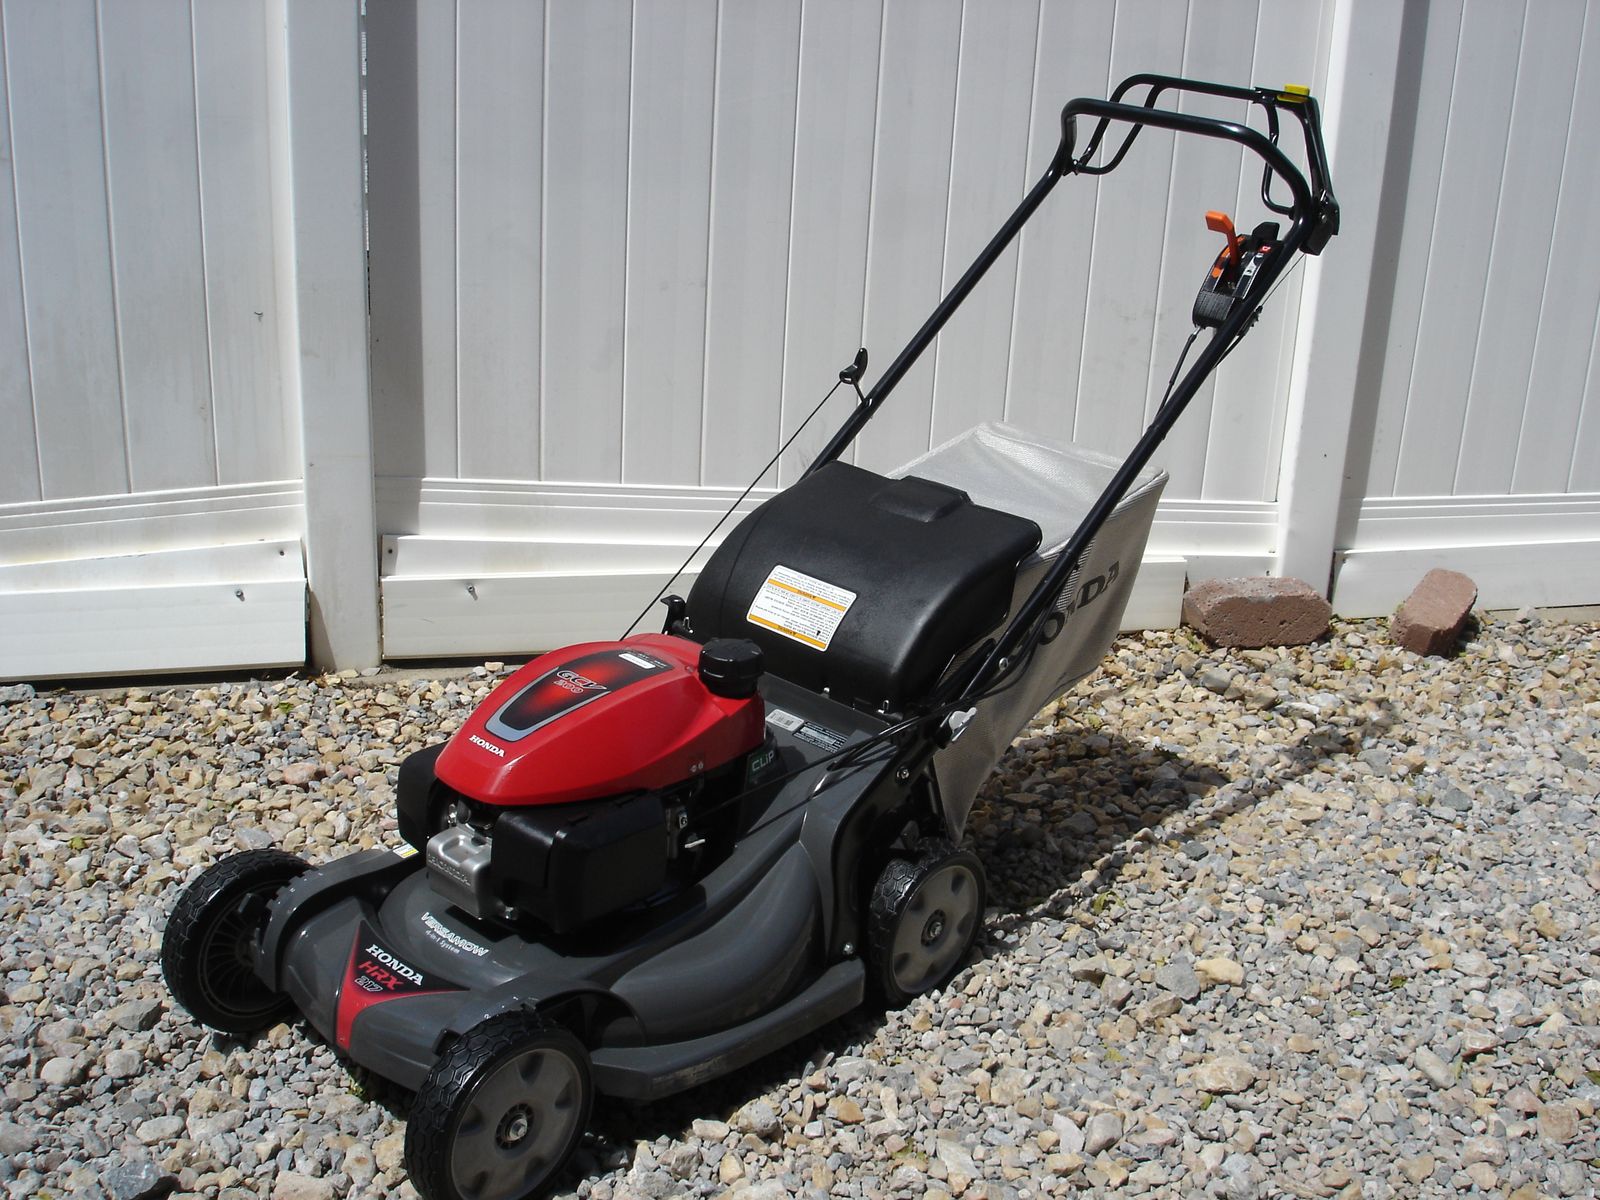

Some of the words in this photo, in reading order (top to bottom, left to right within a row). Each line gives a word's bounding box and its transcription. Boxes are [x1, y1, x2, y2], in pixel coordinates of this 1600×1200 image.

[556, 670, 607, 690] GCV
[469, 735, 505, 758] HONDA
[421, 911, 490, 957] VERSAMOW
[358, 960, 404, 991] HRX
[365, 944, 425, 986] HONDA
[354, 975, 384, 993] 217
